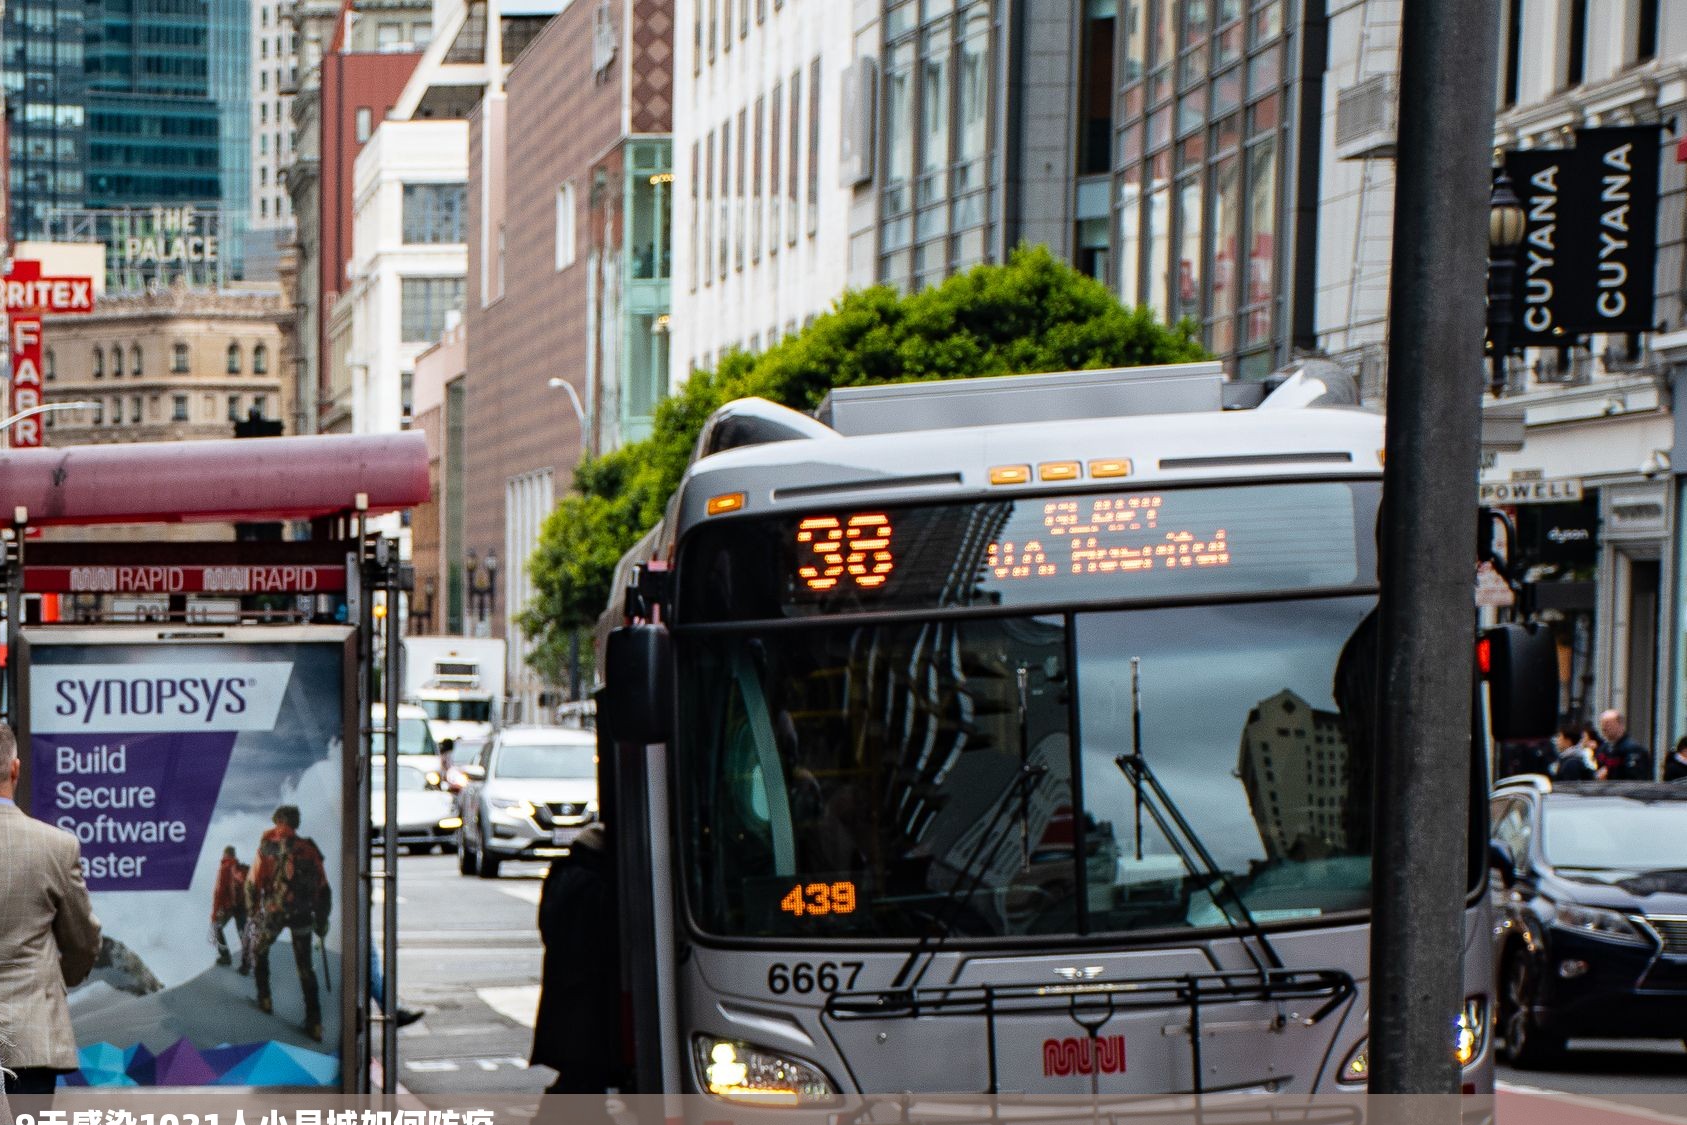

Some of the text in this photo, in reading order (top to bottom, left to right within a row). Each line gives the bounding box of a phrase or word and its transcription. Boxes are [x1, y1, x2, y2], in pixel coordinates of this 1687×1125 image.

[152, 207, 196, 233] THE
[1596, 143, 1632, 318] CUYANA
[126, 236, 218, 262] PALACE
[1524, 165, 1559, 333] CUYANA
[13, 320, 41, 445] FABR
[1480, 483, 1575, 500] POWELL
[1547, 526, 1589, 543] dyson
[797, 511, 894, 592] 38
[119, 567, 184, 591] RAPID
[251, 567, 317, 591] RAPID
[56, 745, 126, 774] Build
[56, 781, 156, 808] Secure
[57, 814, 187, 843] Software
[79, 852, 146, 878] aster
[781, 881, 856, 917] 439
[767, 961, 864, 994] 6667
